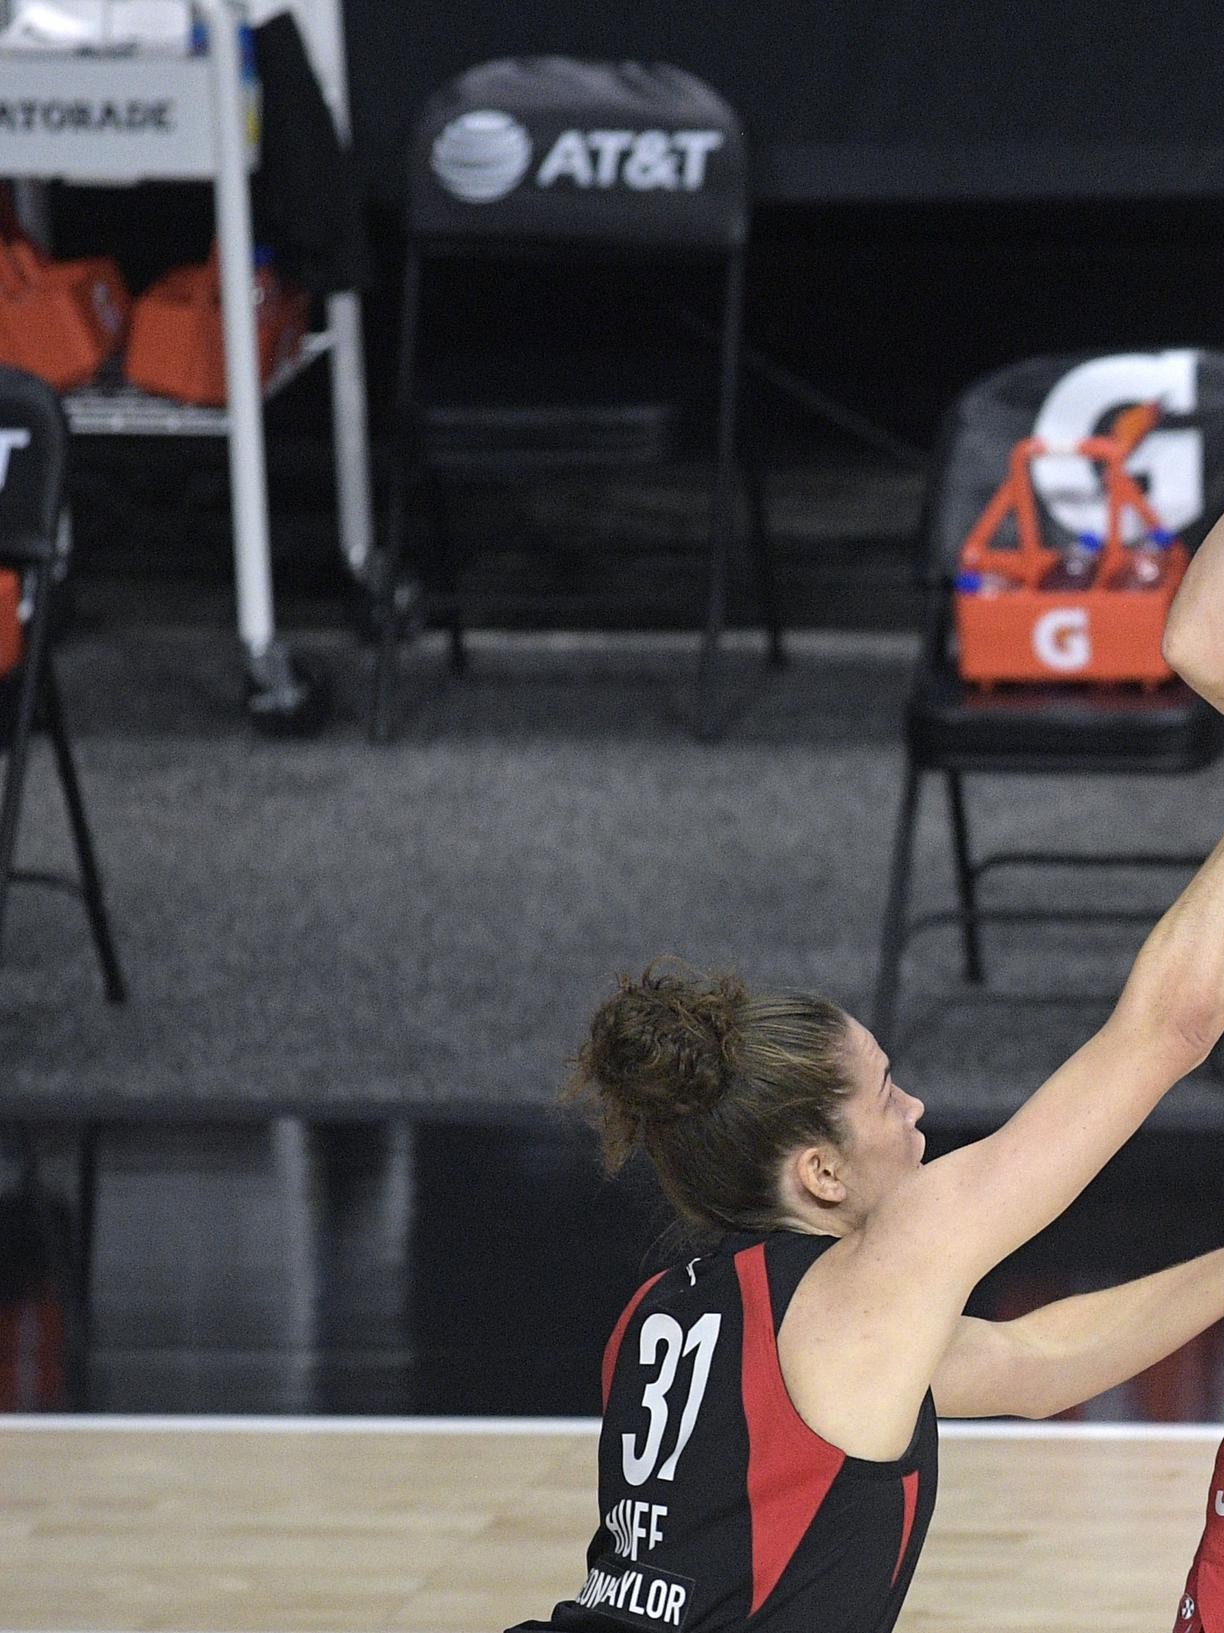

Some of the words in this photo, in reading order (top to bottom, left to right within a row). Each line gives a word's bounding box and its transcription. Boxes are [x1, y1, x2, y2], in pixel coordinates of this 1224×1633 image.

[0, 98, 174, 135] ATORADE
[536, 128, 723, 191] AT&T
[1033, 607, 1091, 670] G
[621, 1313, 722, 1486] 31
[605, 1499, 668, 1562] HUFF
